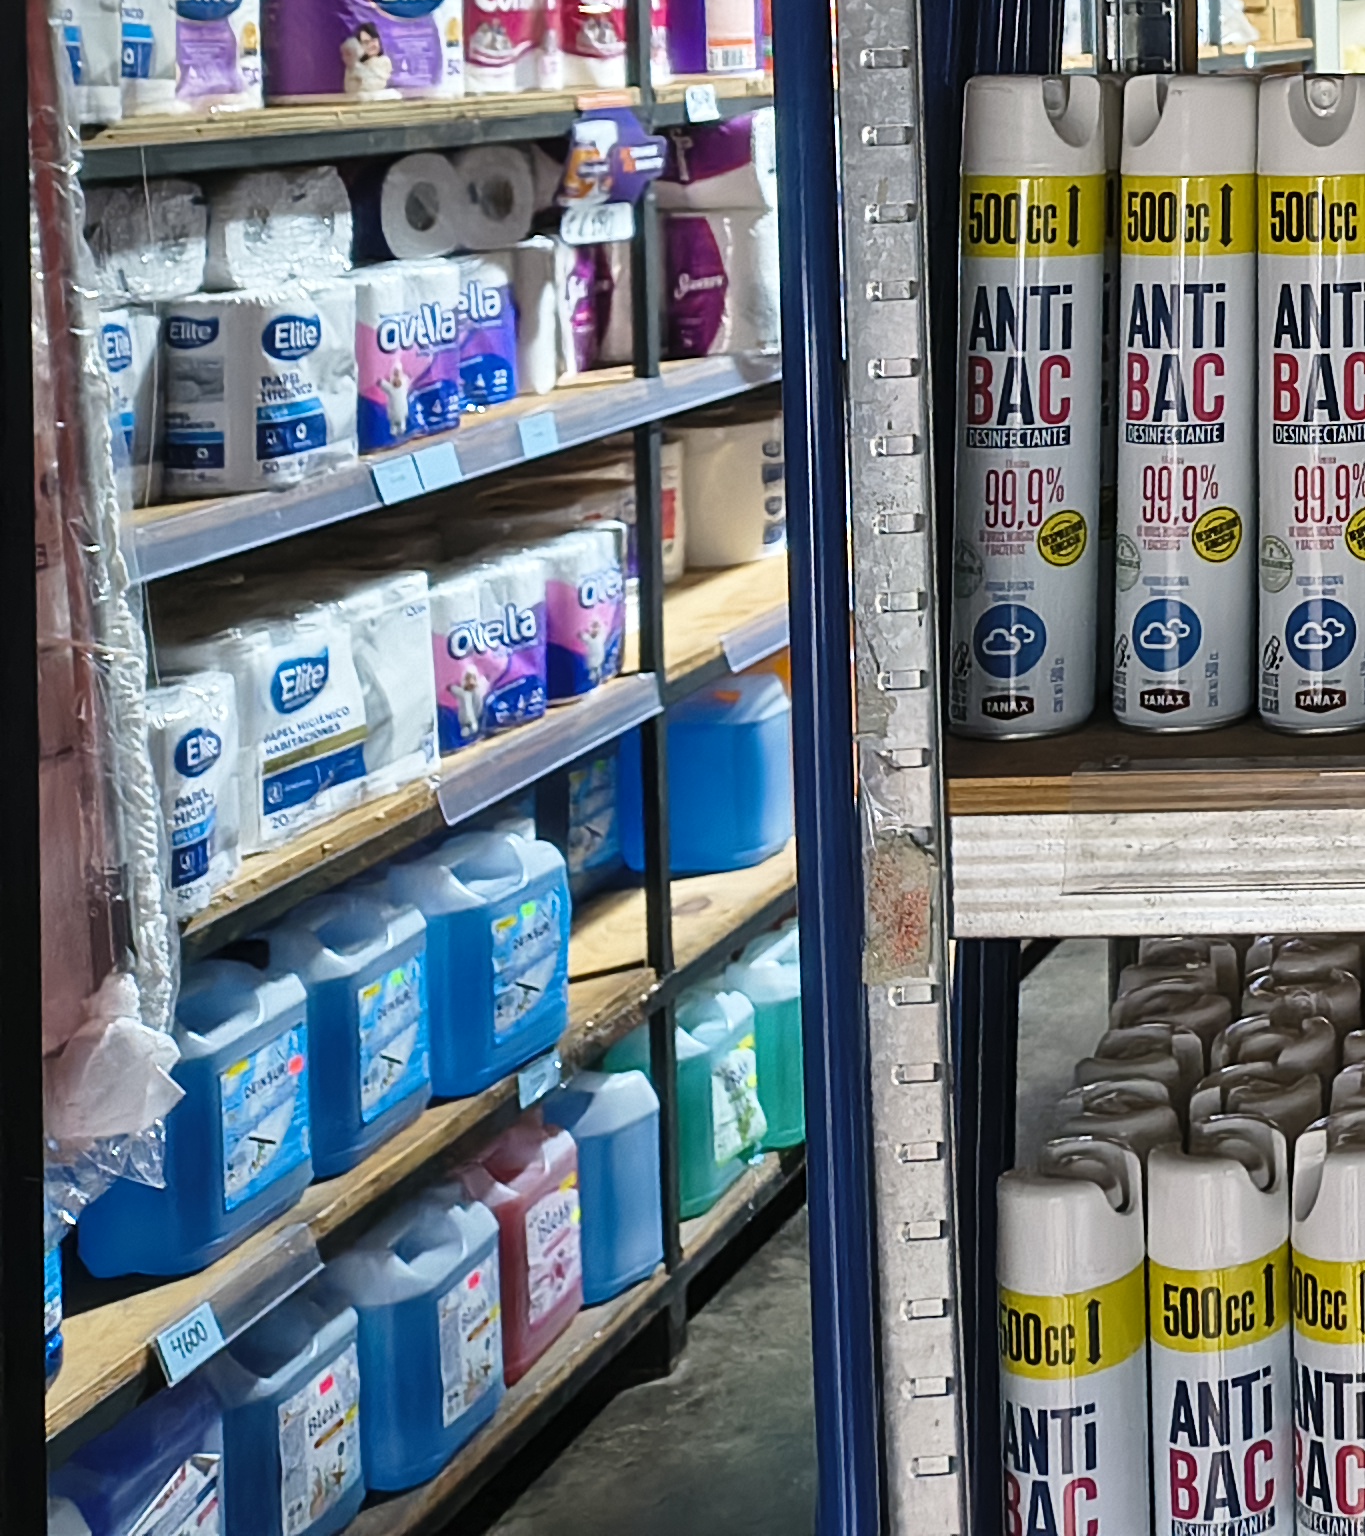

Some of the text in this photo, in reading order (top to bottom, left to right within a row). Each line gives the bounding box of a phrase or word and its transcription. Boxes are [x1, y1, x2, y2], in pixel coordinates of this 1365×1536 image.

[968, 191, 1058, 245] 500cc
[1270, 190, 1357, 243] 500cc
[168, 320, 213, 341] Elite
[273, 320, 320, 350] Elite
[377, 303, 458, 354] ovella
[966, 354, 1071, 426] BAC
[967, 425, 1070, 449] DESINFECTANTE
[448, 605, 537, 660] ovella
[279, 661, 327, 702] Elite
[1299, 691, 1342, 709] TANAX
[984, 698, 1029, 715] TANAX
[270, 813, 290, 830] 20
[1162, 1283, 1256, 1340] 500cc
[168, 1319, 210, 1358] 4600
